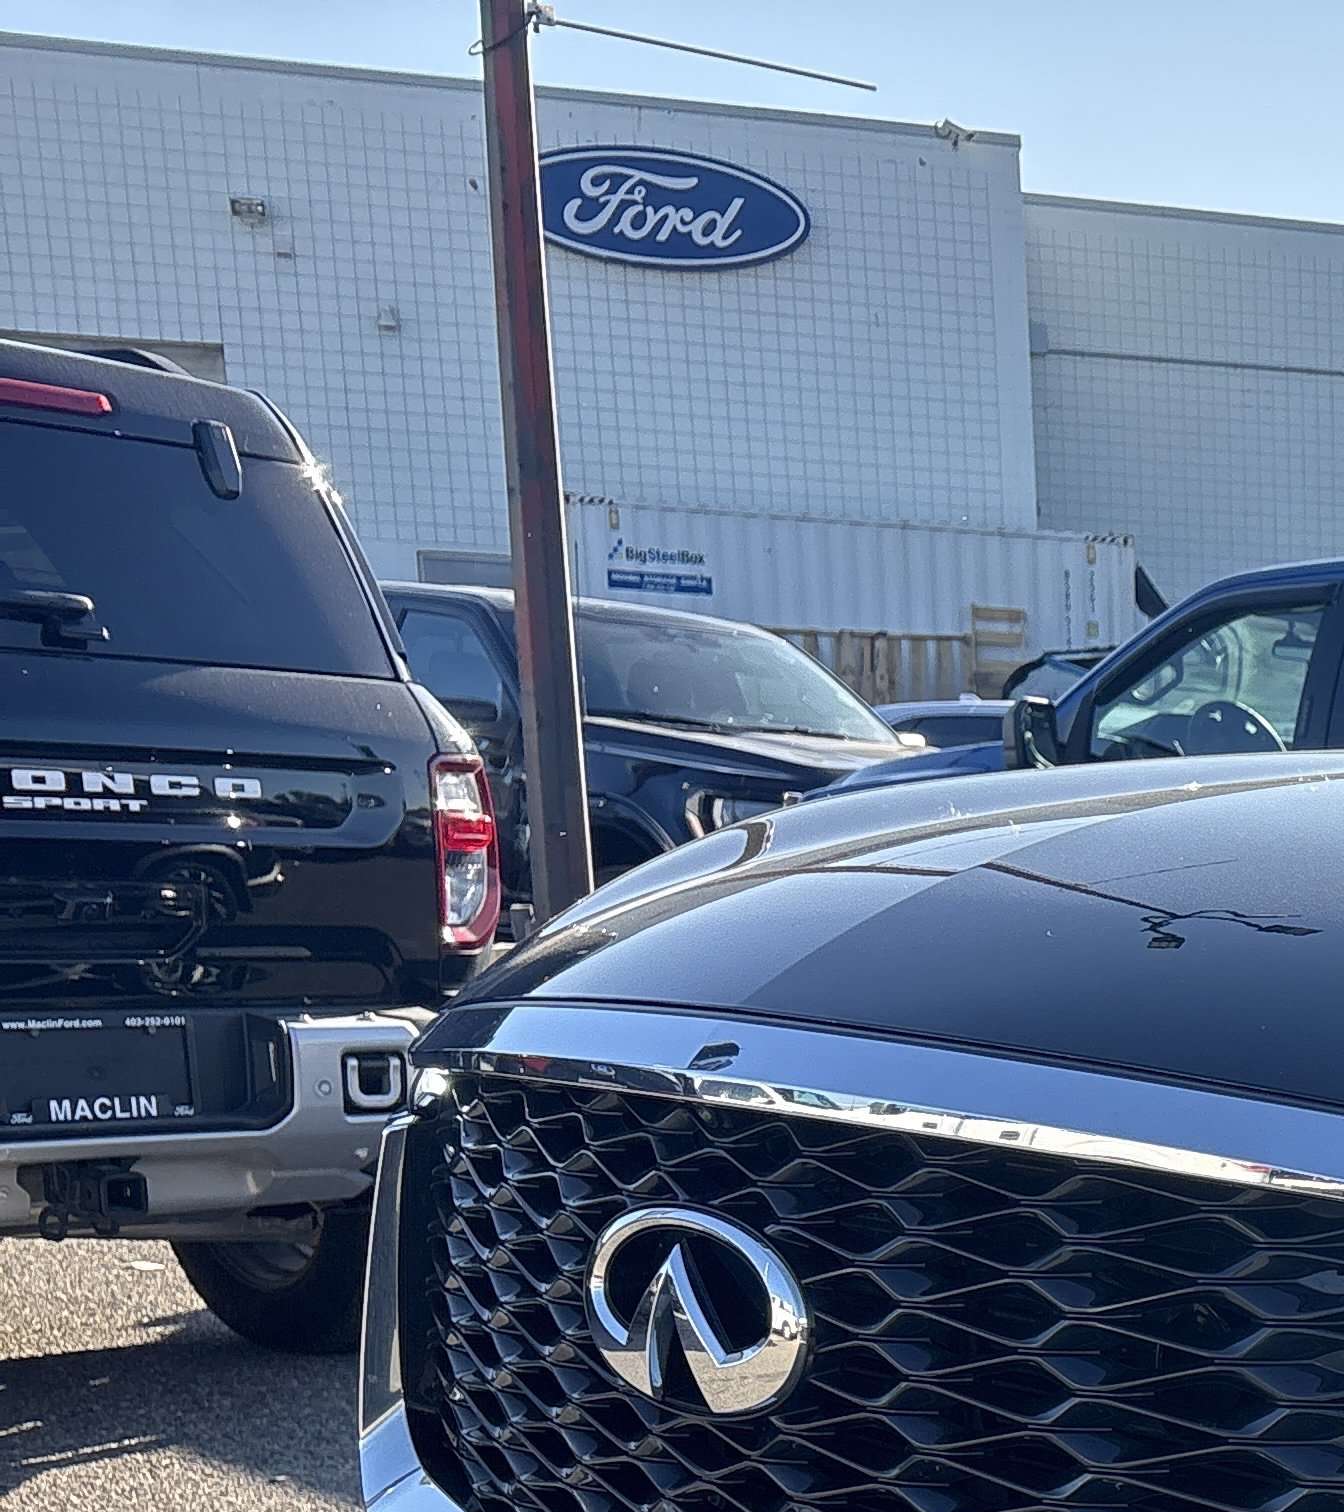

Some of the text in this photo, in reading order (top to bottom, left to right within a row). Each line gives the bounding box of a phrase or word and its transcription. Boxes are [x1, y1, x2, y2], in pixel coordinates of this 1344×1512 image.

[563, 164, 744, 248] Ford
[625, 547, 705, 565] BigSteelBox
[11, 768, 262, 798] ONCO
[2, 795, 149, 812] SPORT
[2, 1019, 102, 1030] www.MaclinFord.com
[51, 1095, 158, 1121] MACLIN
[175, 1105, 194, 1116] Ford
